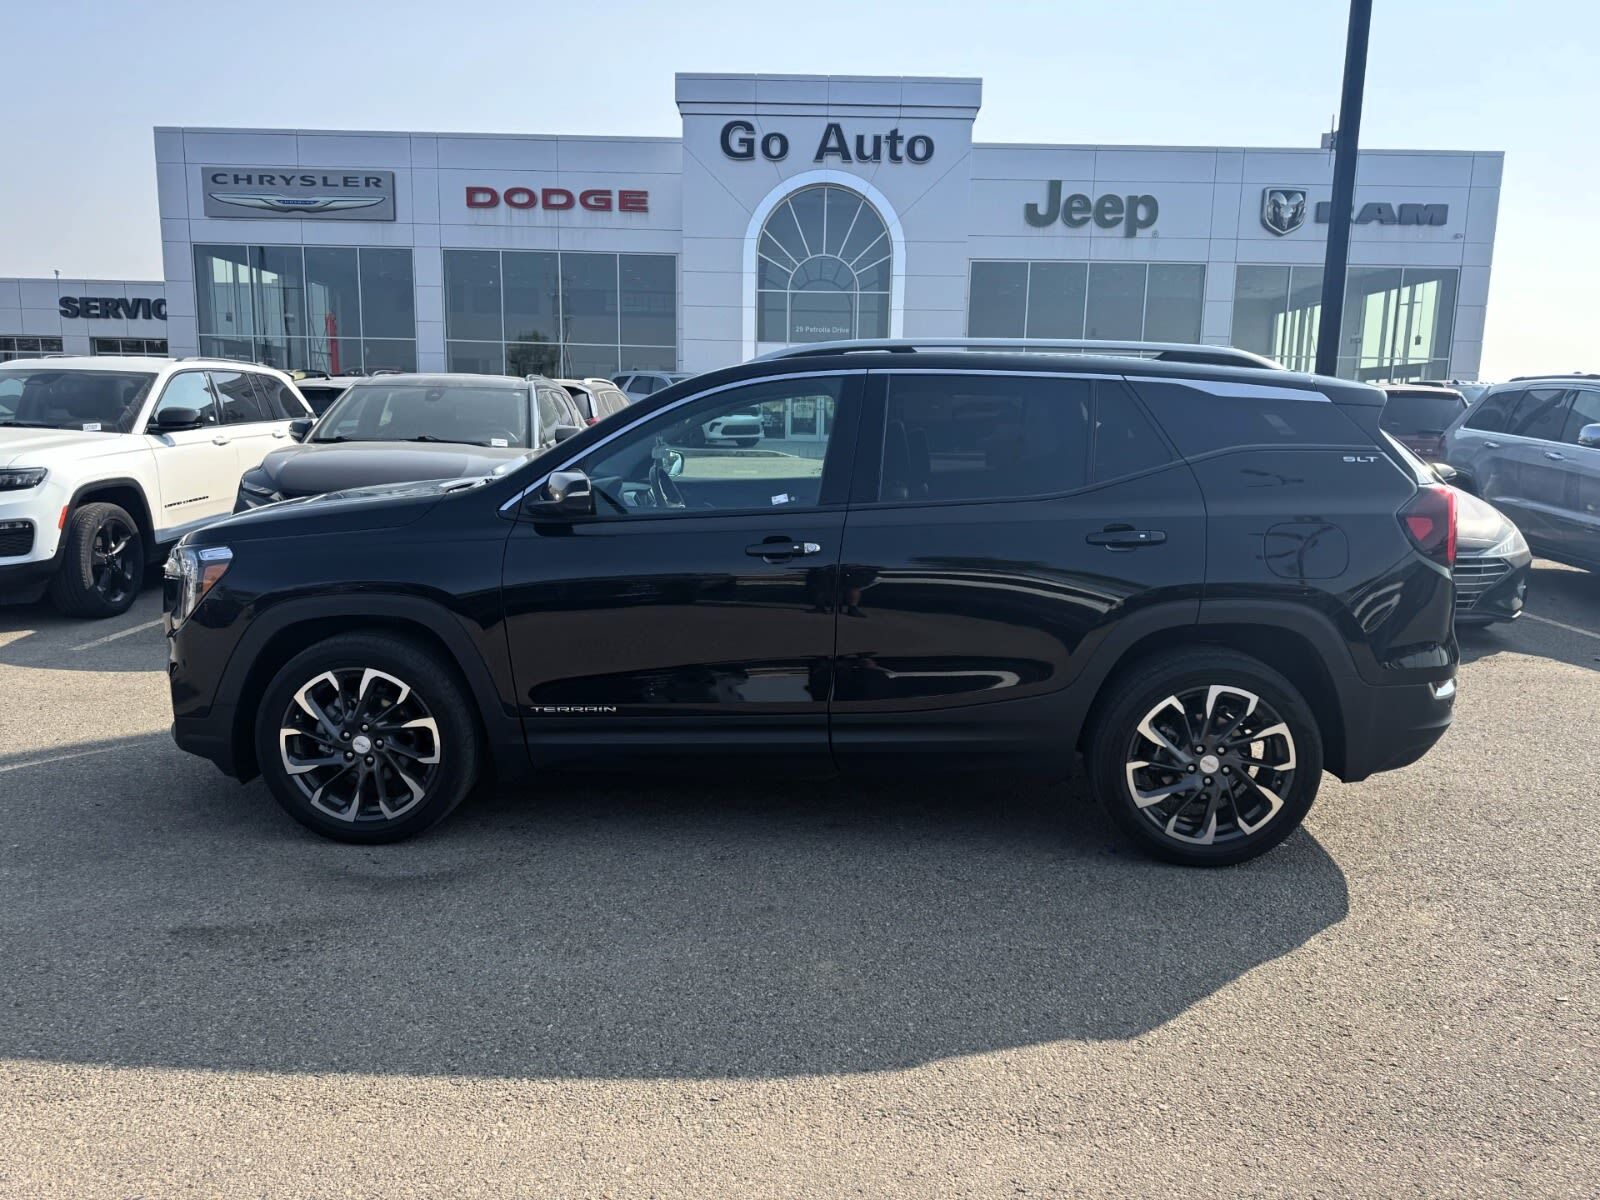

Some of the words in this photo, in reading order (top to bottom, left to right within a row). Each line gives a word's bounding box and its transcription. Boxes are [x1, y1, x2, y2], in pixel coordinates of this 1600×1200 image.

[719, 120, 789, 161] Go
[813, 122, 935, 164] Auto
[211, 173, 383, 188] CHRYSLER
[466, 186, 649, 213] DODGE
[1024, 179, 1159, 238] Jeep
[831, 326, 850, 334] Drive
[530, 705, 617, 713] TERRAIN
